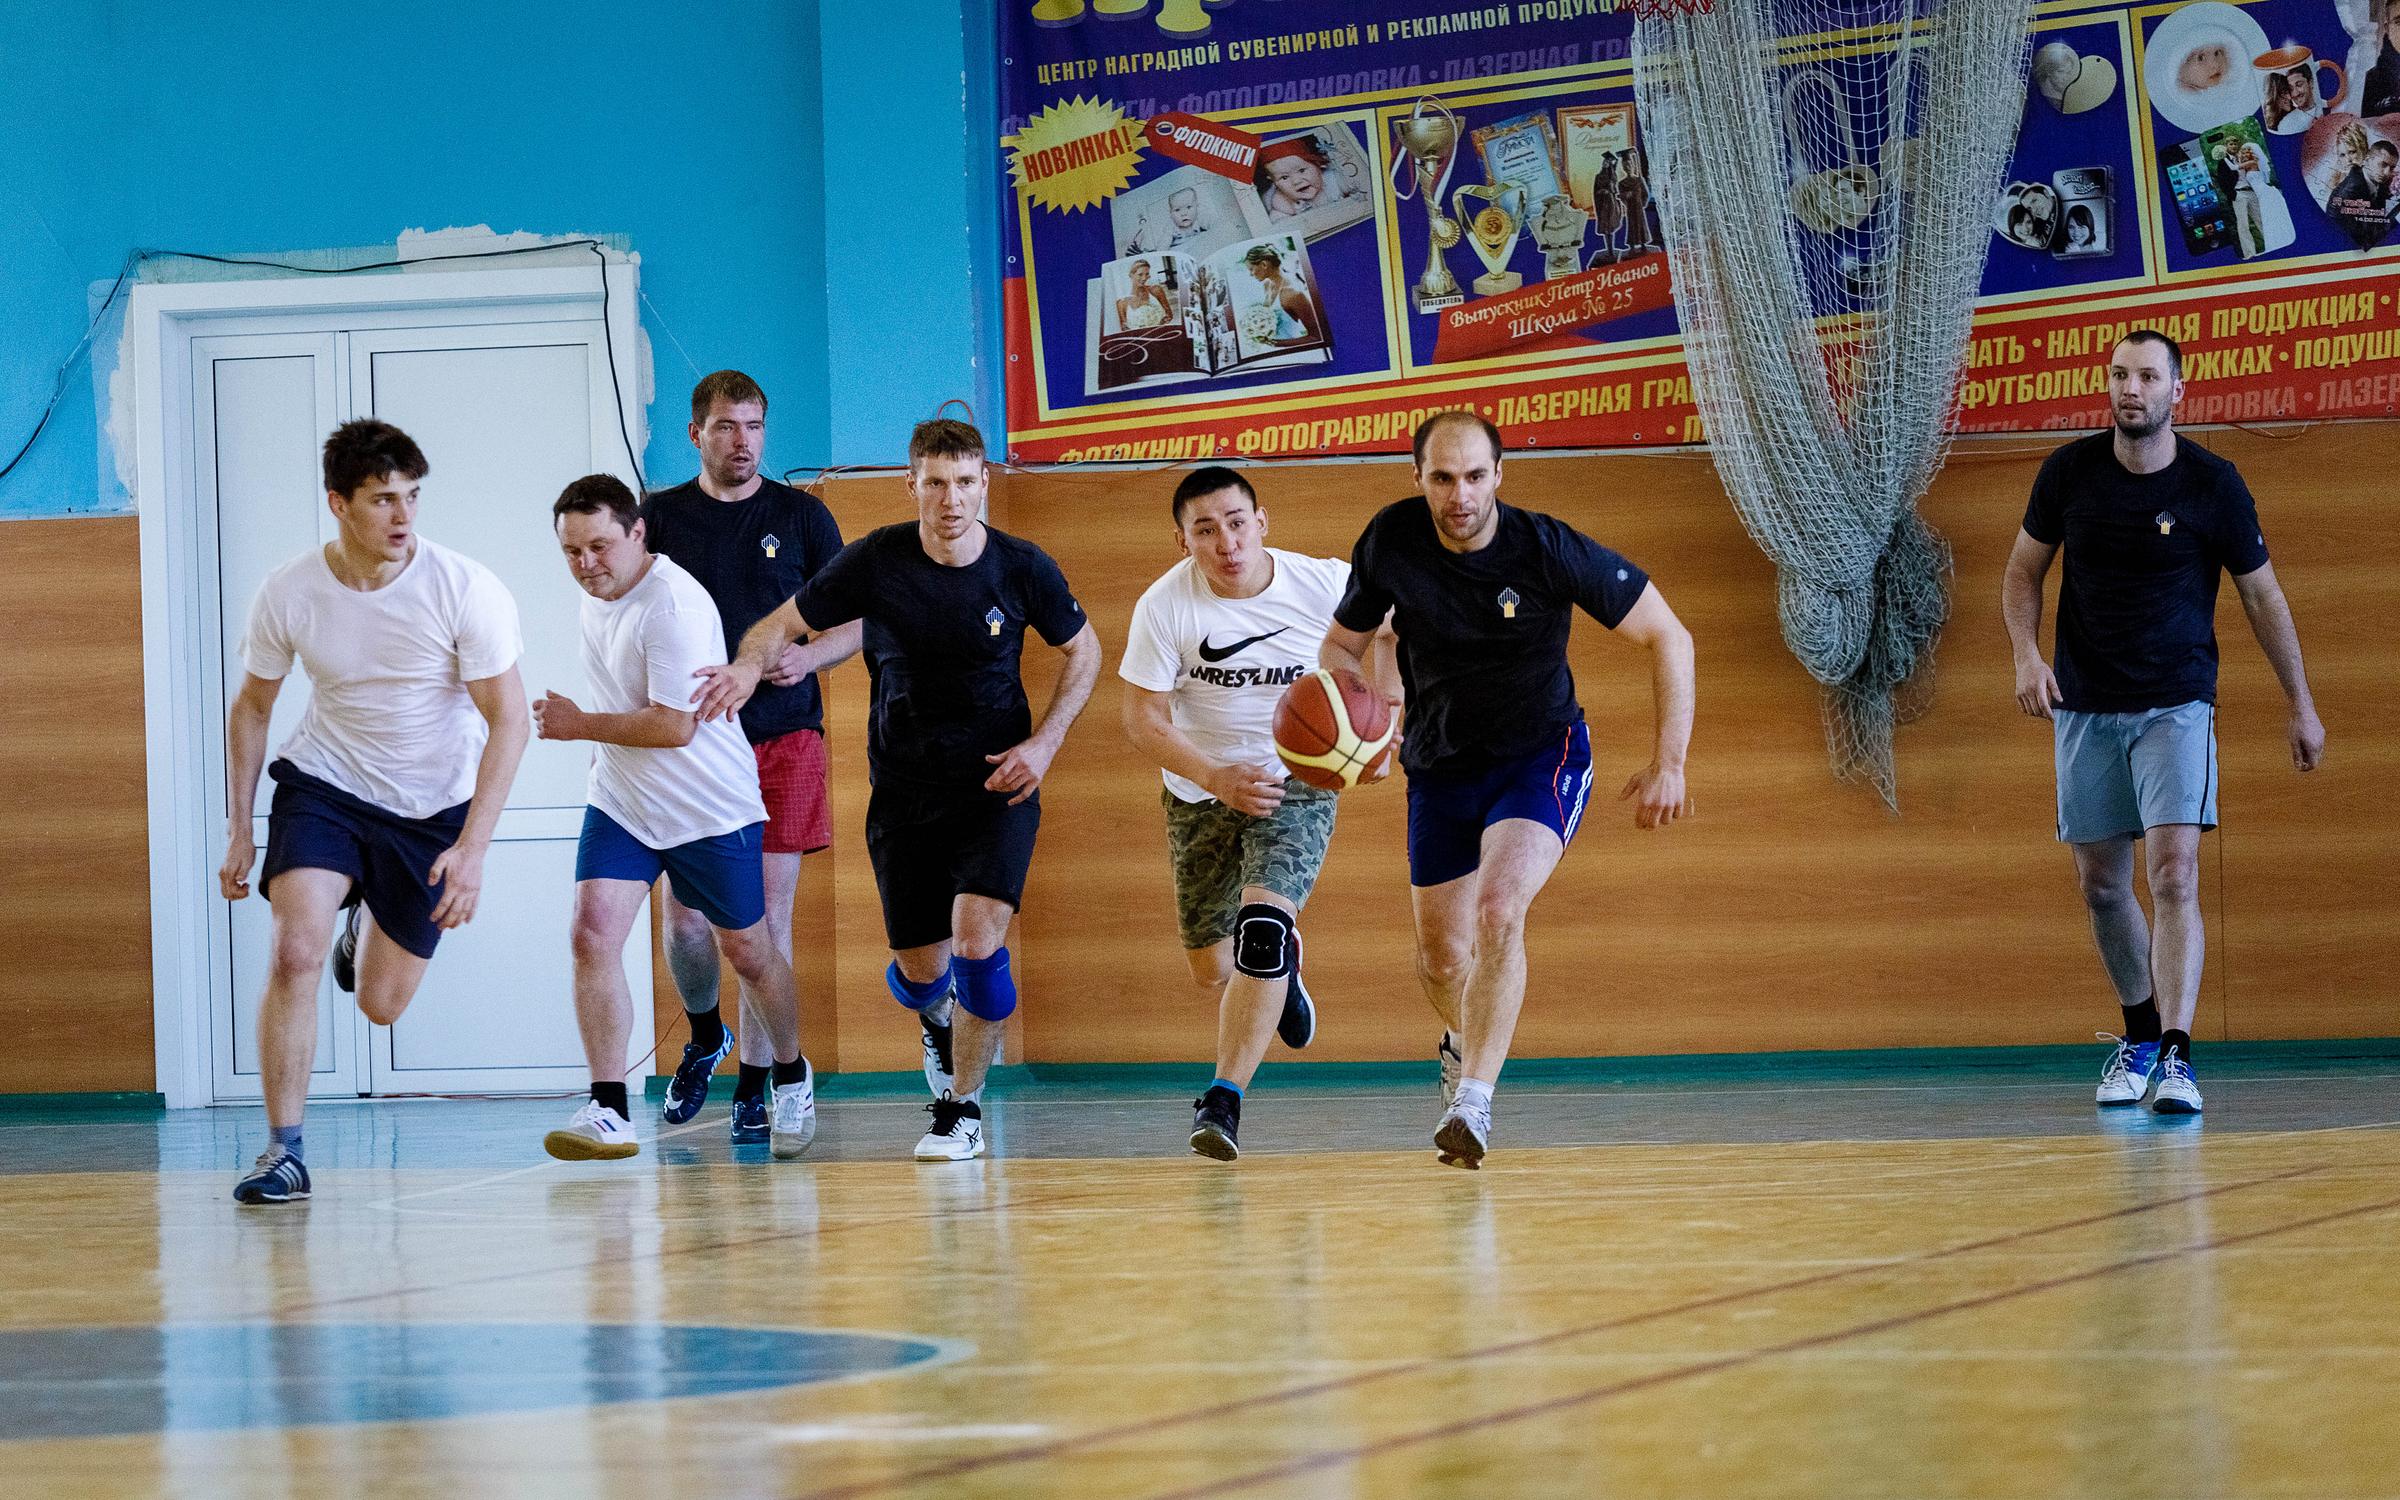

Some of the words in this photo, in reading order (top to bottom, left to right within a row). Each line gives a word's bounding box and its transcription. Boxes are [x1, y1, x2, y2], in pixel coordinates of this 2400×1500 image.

[1037, 58, 1099, 86] ЦЕНТР
[1105, 41, 1221, 76] НАГРАДНОЙ
[1228, 23, 1359, 61] СУВЕНИРНОЙ
[1367, 24, 1380, 44] И
[1387, 4, 1511, 41] РЕКЛАМНОЙ
[1517, 0, 1636, 23] ПРОДУКЦ
[1178, 64, 1422, 114] ФОТОГРАВИРОВКА
[1444, 43, 1580, 81] ЛАЗЕРНАЯ
[1023, 125, 1134, 183] НОВИНКА!
[1173, 125, 1256, 168] ФОТОКНИГИ
[1450, 294, 1544, 328] Выпускник
[1548, 279, 1595, 302] Петр
[1597, 262, 1660, 292] Иванов
[1508, 311, 1578, 339] Школа
[1584, 298, 1607, 319] №
[1612, 287, 1634, 311] 25
[2212, 291, 2376, 339] ПРОДУКЦИЯ
[1495, 383, 1632, 427] ЛАЗЕРНАЯ
[1960, 364, 2111, 410] ФУТБОЛКА
[2181, 344, 2274, 383] УЖКАХ
